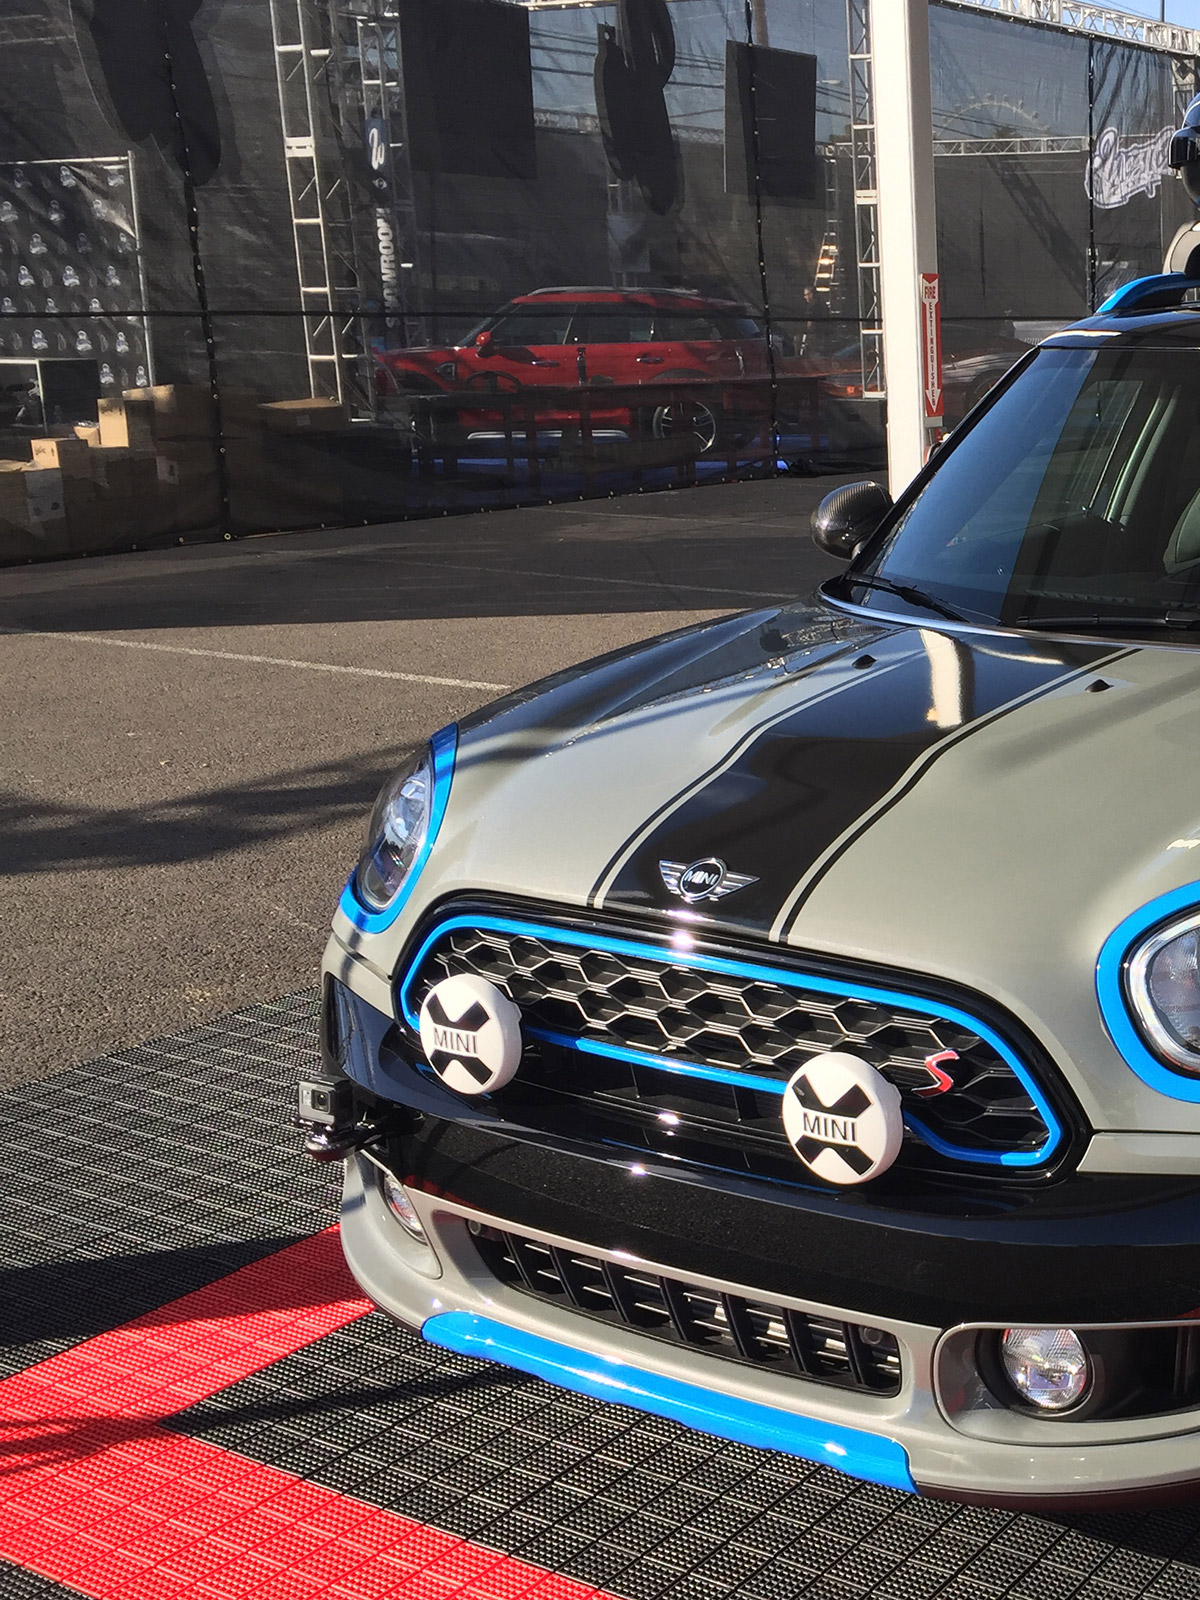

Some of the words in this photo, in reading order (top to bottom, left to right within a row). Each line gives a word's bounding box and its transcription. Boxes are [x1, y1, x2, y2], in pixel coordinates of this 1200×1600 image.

[924, 285, 936, 299] FIRE
[928, 302, 937, 406] EXTINGUISHER
[683, 869, 719, 885] MINI
[433, 1027, 478, 1055] MINI
[911, 1048, 960, 1098] S
[803, 1112, 857, 1142] MINI
